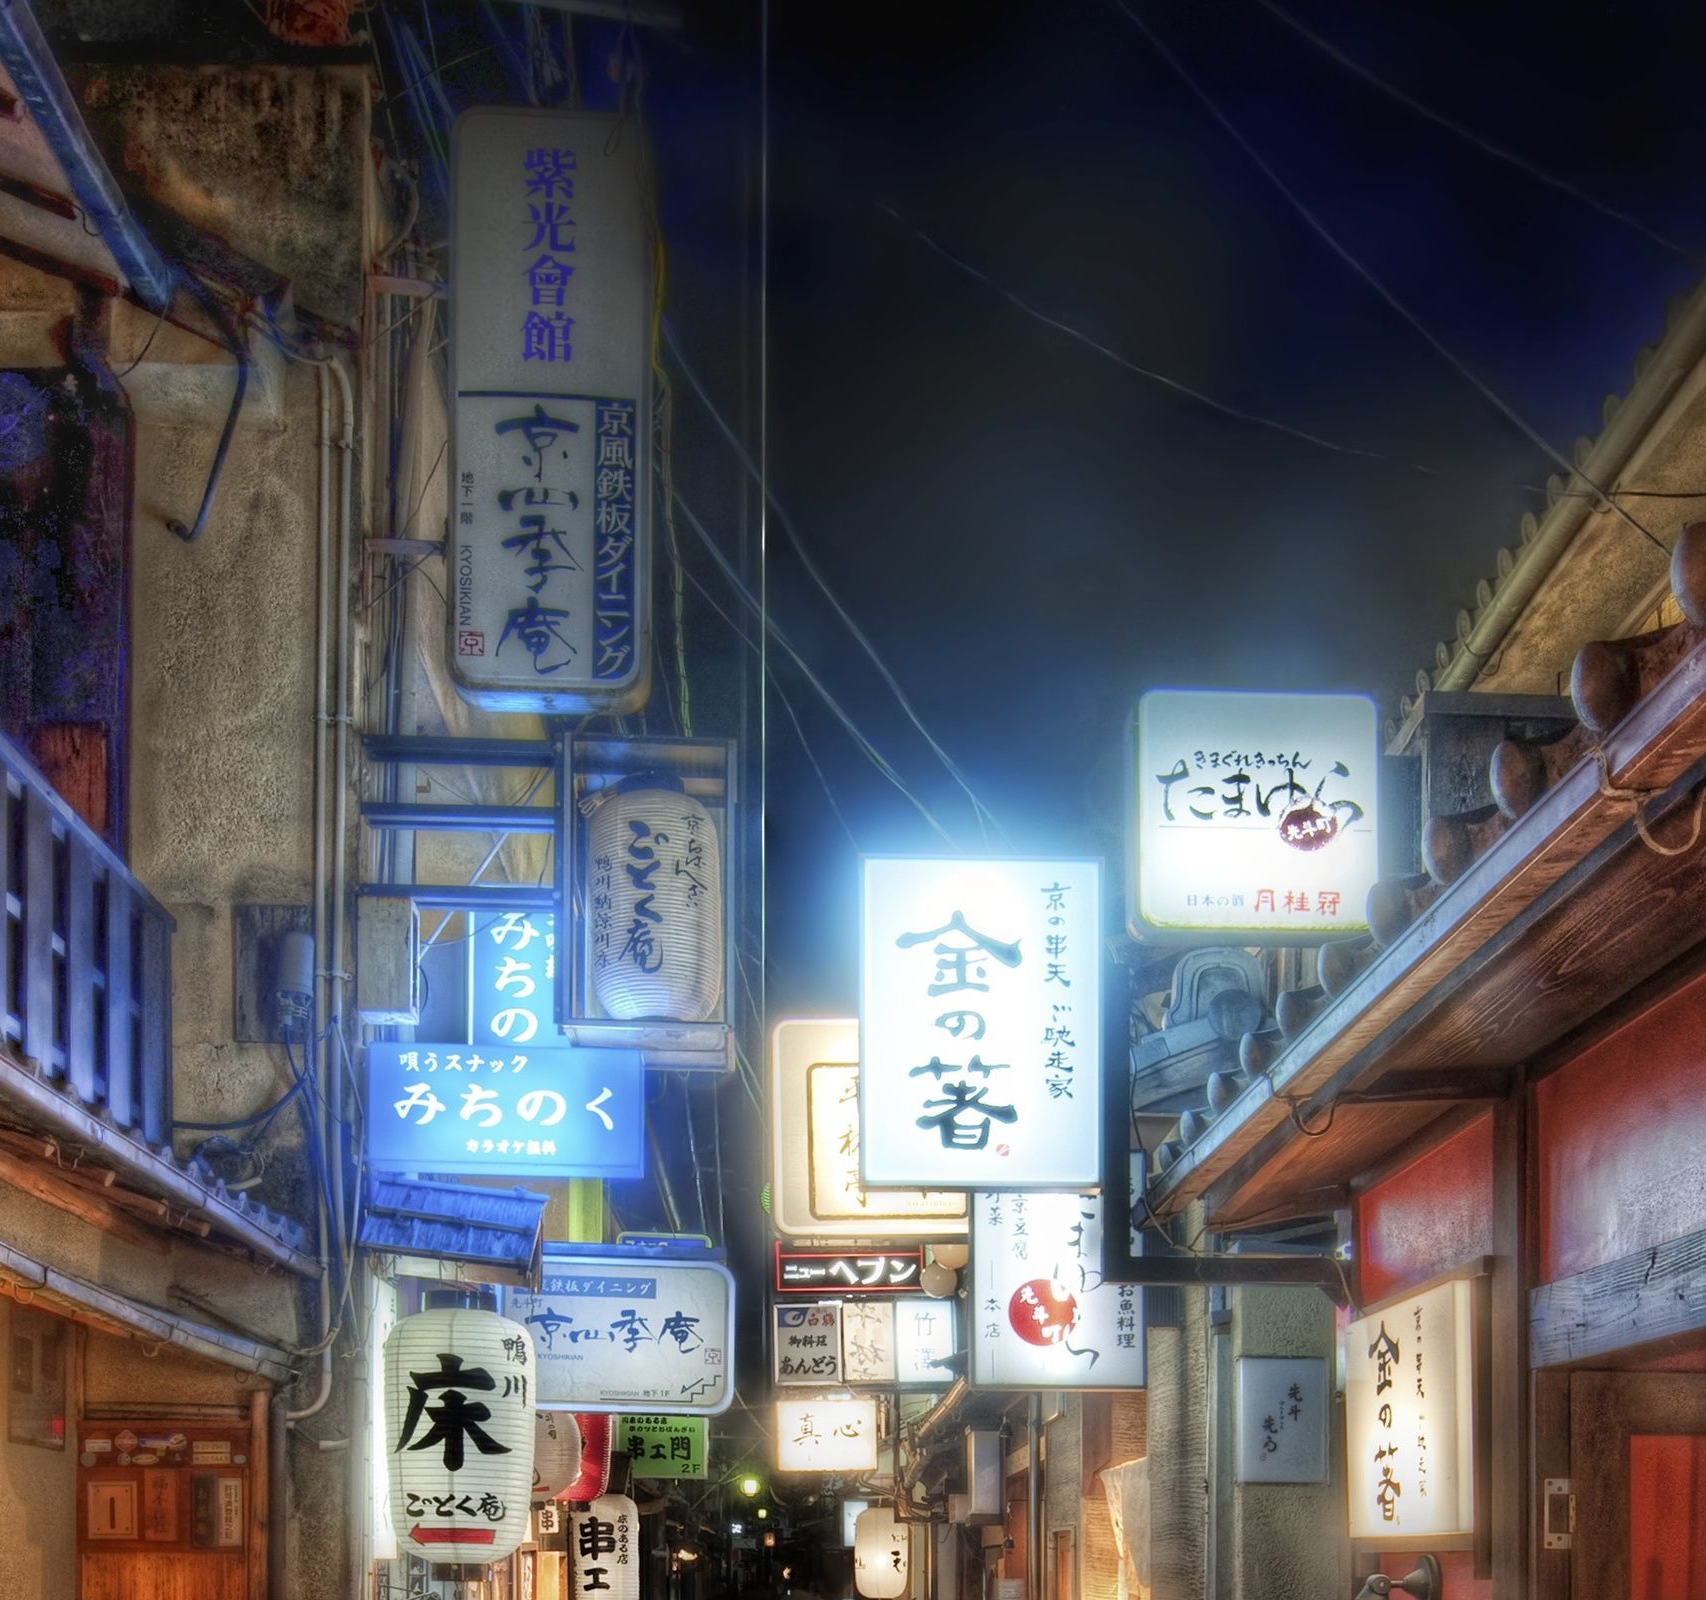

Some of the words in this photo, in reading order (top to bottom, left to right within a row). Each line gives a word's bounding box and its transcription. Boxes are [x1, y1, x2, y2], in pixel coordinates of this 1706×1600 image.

[521, 146, 577, 362] 紫光會館
[460, 471, 474, 525] 地下一階
[596, 402, 635, 676] 京風鉄板ダイニング
[459, 544, 473, 626] KYOSIKIAN
[1193, 750, 1312, 769] きまぐれきっちん
[1156, 758, 1364, 832] たまゆら
[618, 820, 670, 975] ごとく庵
[1254, 888, 1340, 916] 月桂冠
[1041, 881, 1072, 988] 京の串天
[399, 1052, 529, 1073] 唄うスナック
[393, 1082, 614, 1131] みちのく
[466, 1139, 557, 1156] カラオケ無料
[783, 1256, 917, 1285] ニューヘブン
[1117, 1286, 1136, 1348] お魚料理
[501, 1335, 527, 1409] 鴨川
[537, 1353, 584, 1361] KYOSHIKIAN
[780, 1354, 837, 1376] あんどう
[394, 1353, 513, 1471] 床
[793, 1413, 862, 1446] 真心
[681, 1463, 701, 1474] 2F
[406, 1492, 506, 1522] ごとく庵
